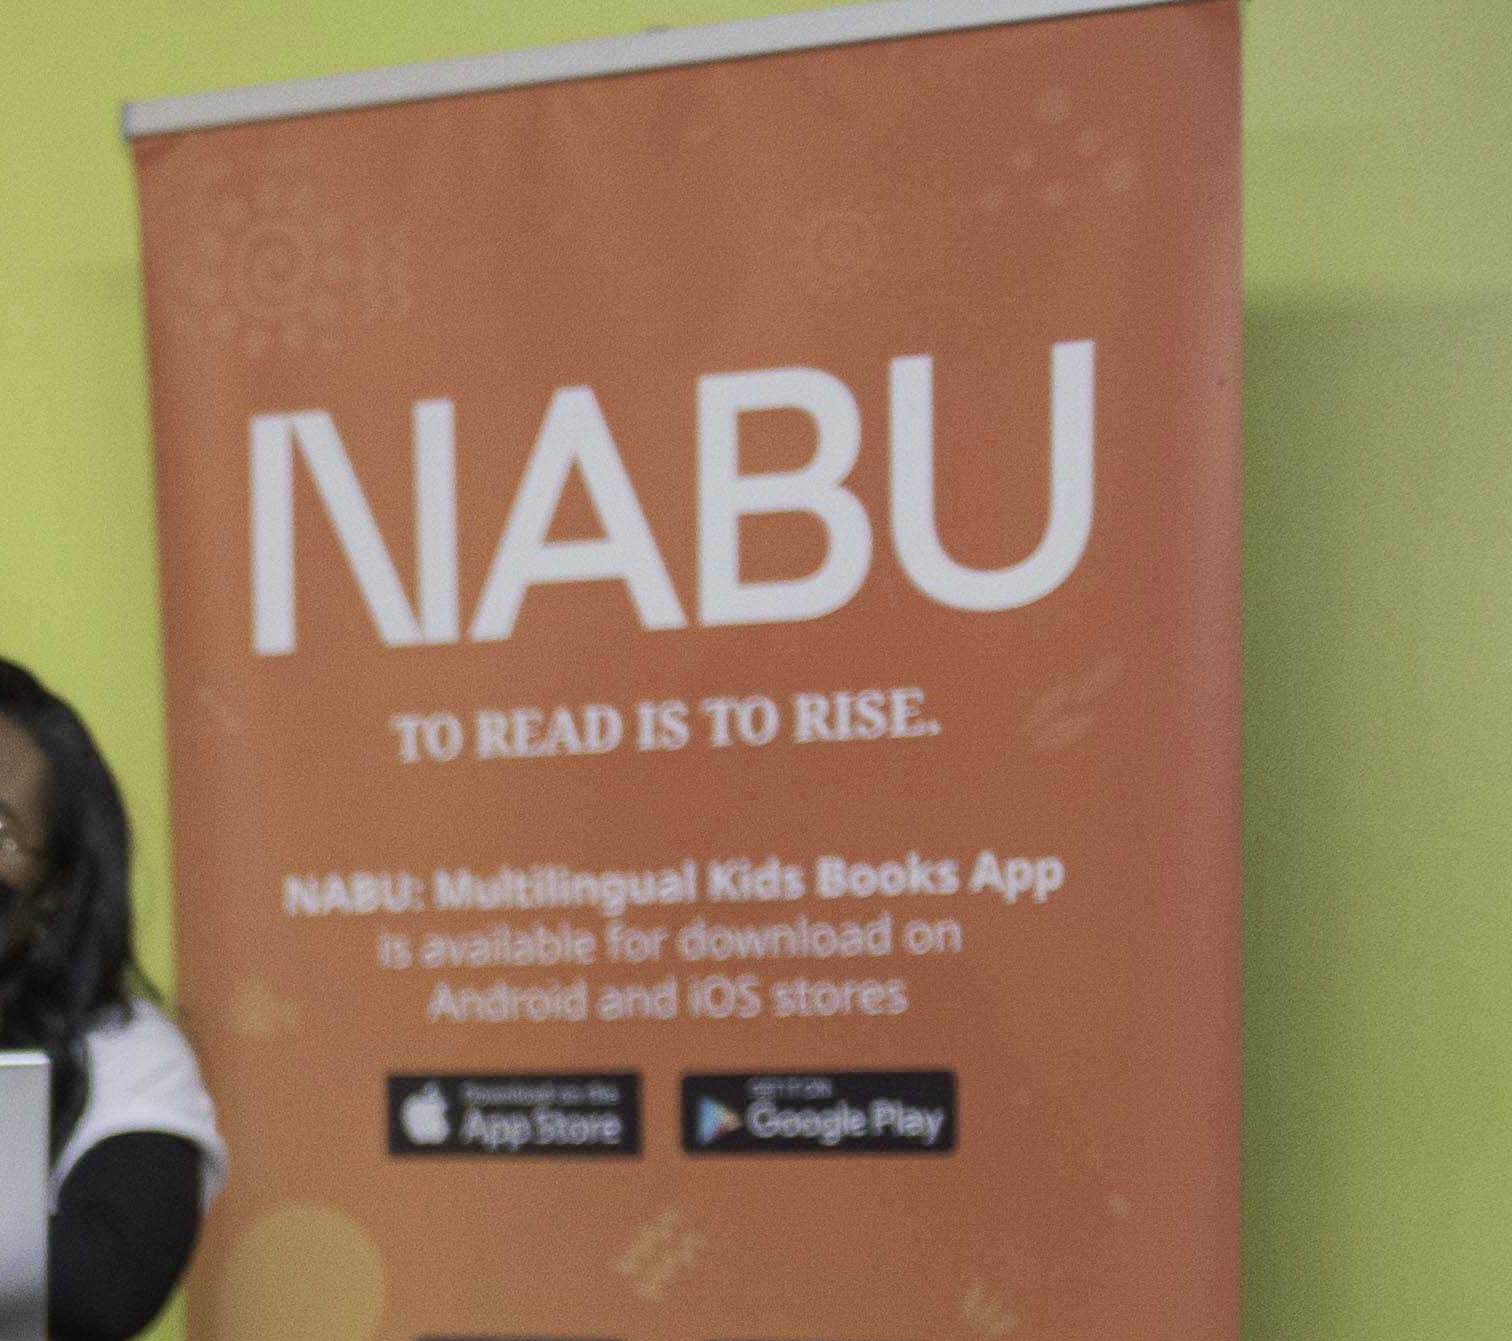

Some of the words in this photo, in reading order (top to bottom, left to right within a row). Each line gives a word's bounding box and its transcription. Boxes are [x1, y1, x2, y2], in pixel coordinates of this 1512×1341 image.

[250, 339, 1095, 656] NABU
[392, 714, 462, 763] TO
[476, 706, 622, 762] READ
[637, 701, 689, 749] IS
[702, 696, 778, 749] TO
[794, 687, 942, 741] RISE.
[283, 872, 425, 916] NABU:
[434, 865, 695, 919] Multilingual
[709, 857, 803, 901] Kids
[817, 854, 958, 897] Books
[970, 851, 1064, 903] App
[378, 930, 411, 968] is
[423, 923, 595, 967] available
[607, 919, 665, 962] for
[678, 914, 892, 961] download
[905, 920, 962, 954] on
[430, 979, 588, 1022] Android
[598, 976, 678, 1020] and
[687, 976, 760, 1019] iOS
[775, 976, 909, 1017] stores
[462, 1108, 533, 1150] App
[535, 1106, 623, 1145] Store
[747, 1100, 866, 1146] Google
[871, 1099, 944, 1145] Play
